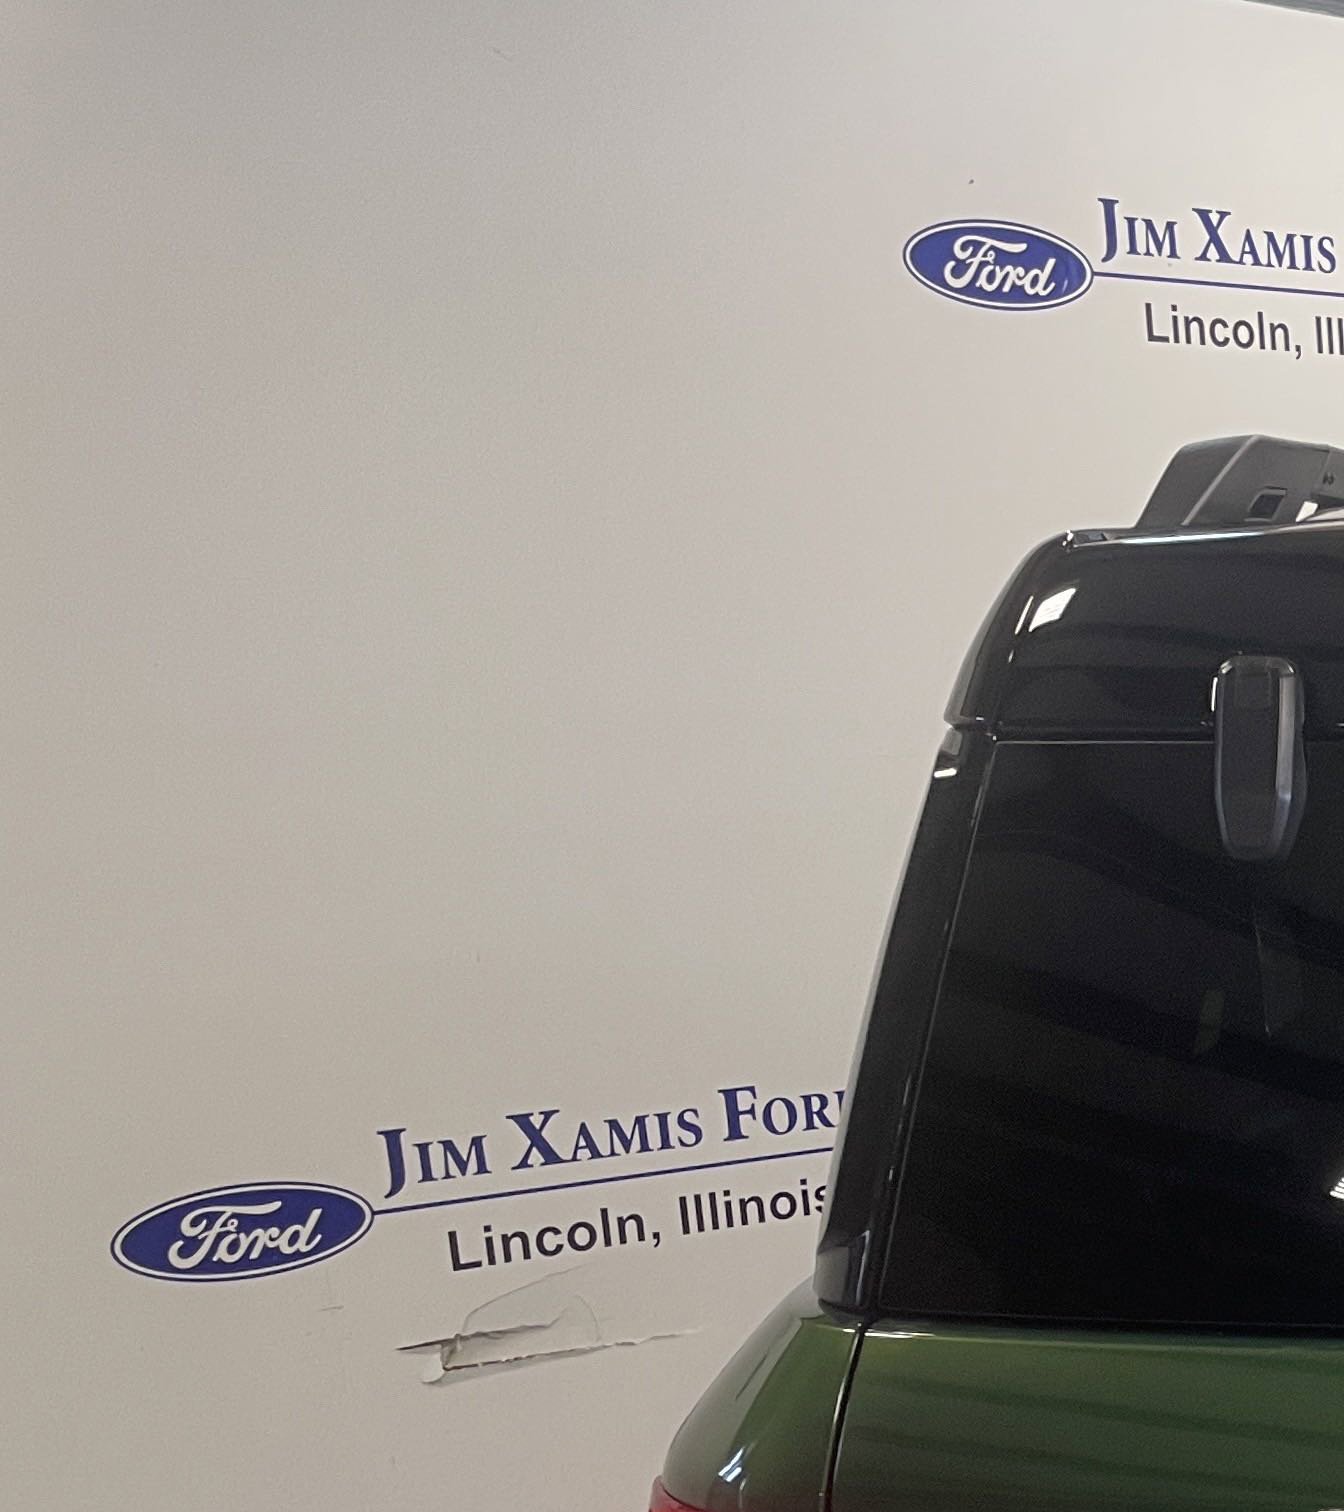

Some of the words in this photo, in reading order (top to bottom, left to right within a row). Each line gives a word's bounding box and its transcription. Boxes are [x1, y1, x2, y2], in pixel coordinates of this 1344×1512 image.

[944, 234, 1056, 297] Ford
[1144, 302, 1303, 361] Lincoln,
[166, 1199, 324, 1271] Ford
[447, 1204, 663, 1272] Lincoln,
